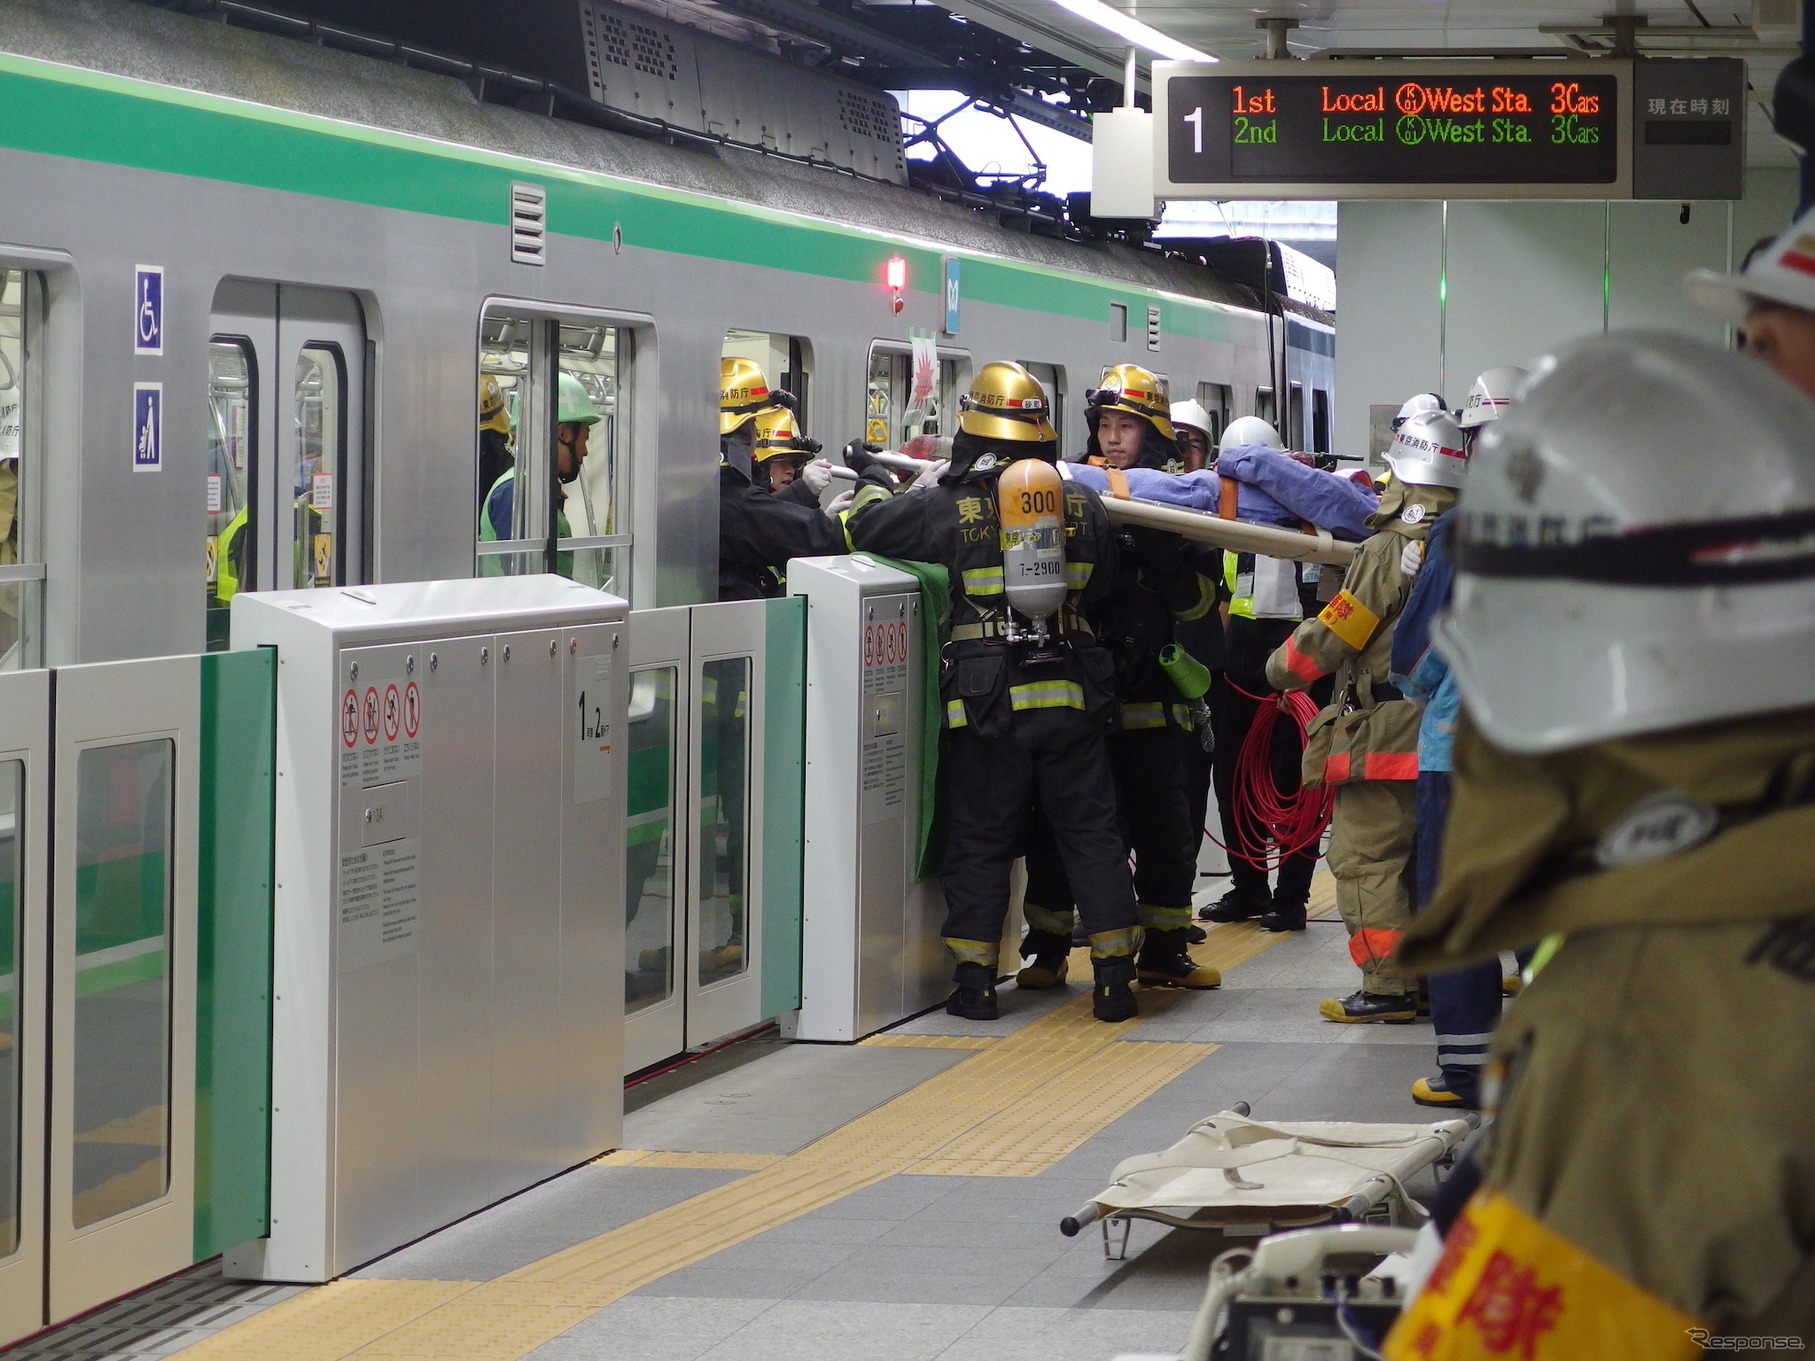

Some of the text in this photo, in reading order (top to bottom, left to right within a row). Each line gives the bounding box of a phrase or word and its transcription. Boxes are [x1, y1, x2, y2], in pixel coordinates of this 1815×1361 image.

[1233, 86, 1385, 113] 1st Local
[1425, 87, 1485, 113] West
[1492, 87, 1532, 113] Sta.
[1647, 98, 1729, 115] 現在時刻
[1184, 107, 1202, 153] 1
[1234, 116, 1385, 143] 2nd Local
[1425, 118, 1485, 142] West
[1492, 118, 1532, 142] Sta.
[1021, 490, 1055, 513] 300
[961, 525, 995, 543] TOK
